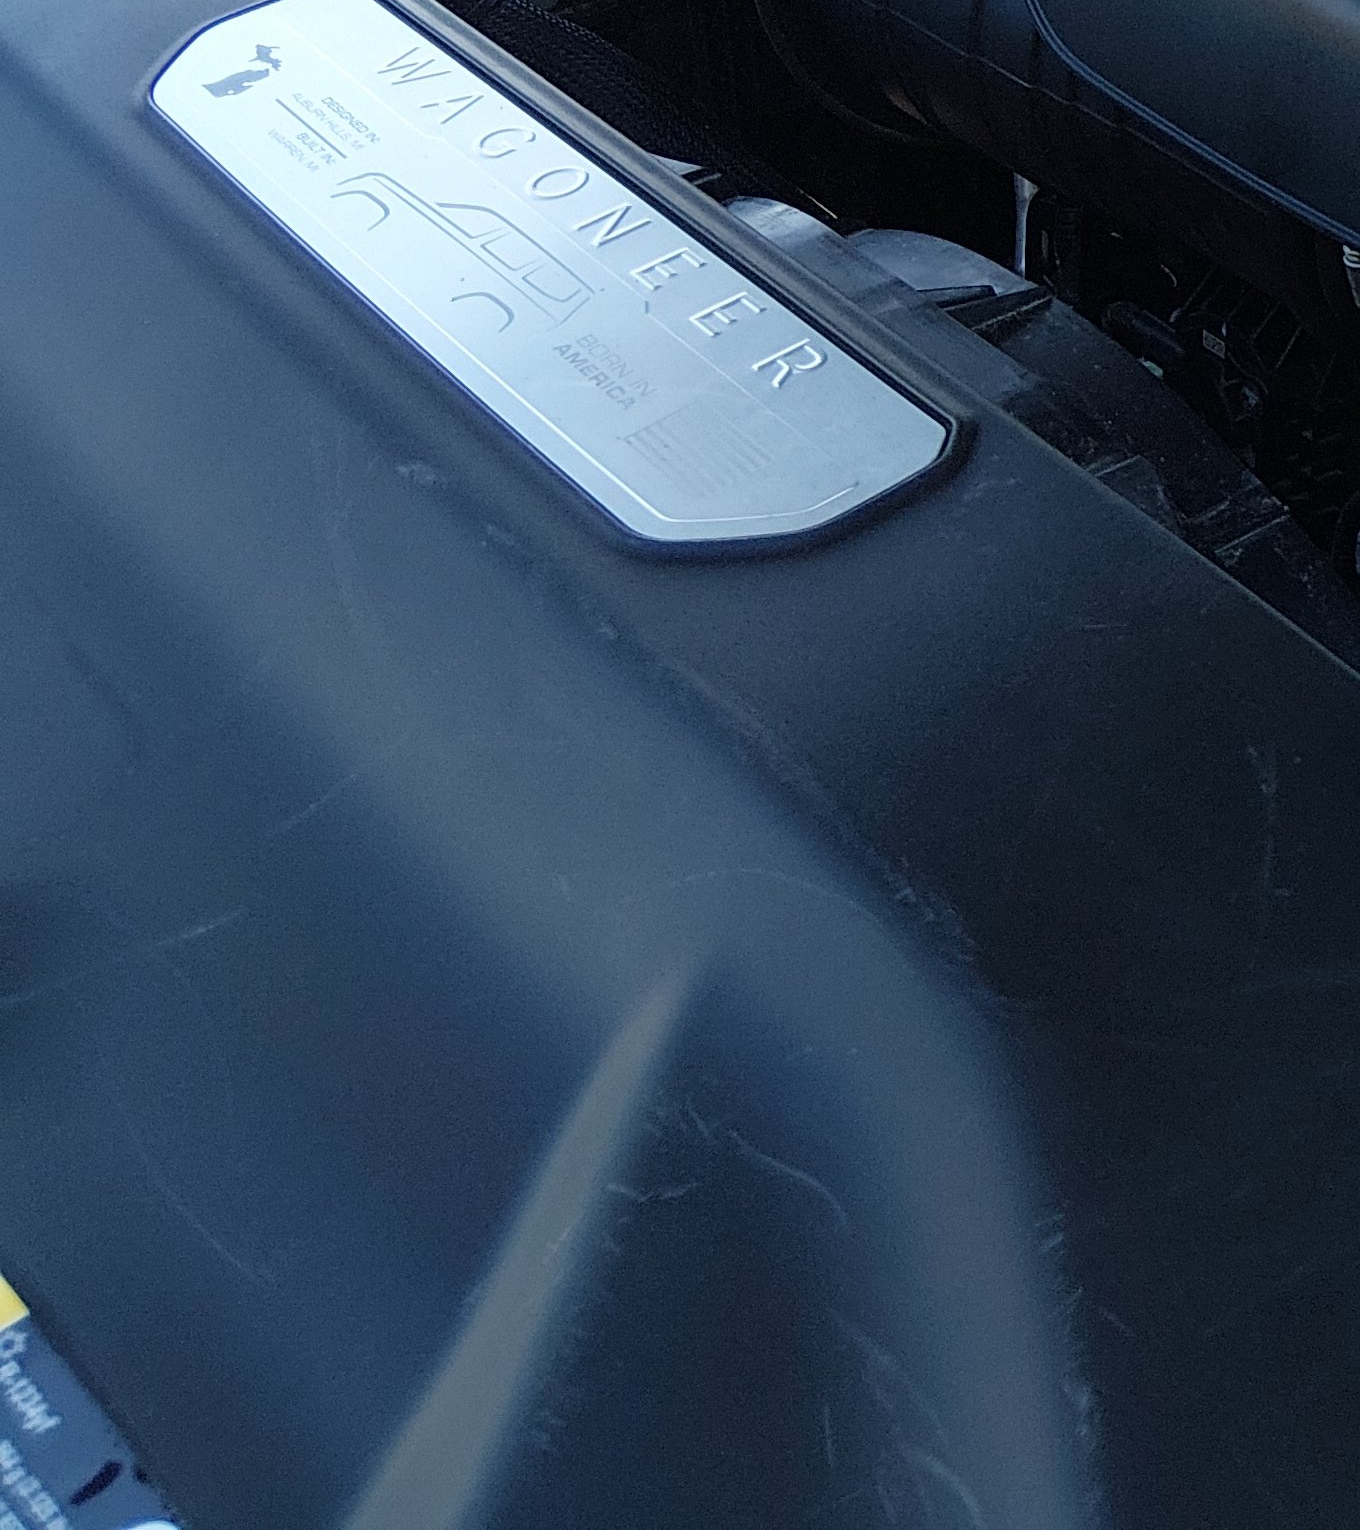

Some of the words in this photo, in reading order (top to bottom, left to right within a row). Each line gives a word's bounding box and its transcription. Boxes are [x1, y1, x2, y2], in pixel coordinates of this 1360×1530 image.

[295, 132, 326, 156] BUILT
[320, 96, 369, 134] DESIGNED
[378, 47, 829, 388] WAGONEER
[551, 342, 638, 409] AMERICA
[575, 332, 634, 378] BORN
[623, 373, 657, 398] IN
